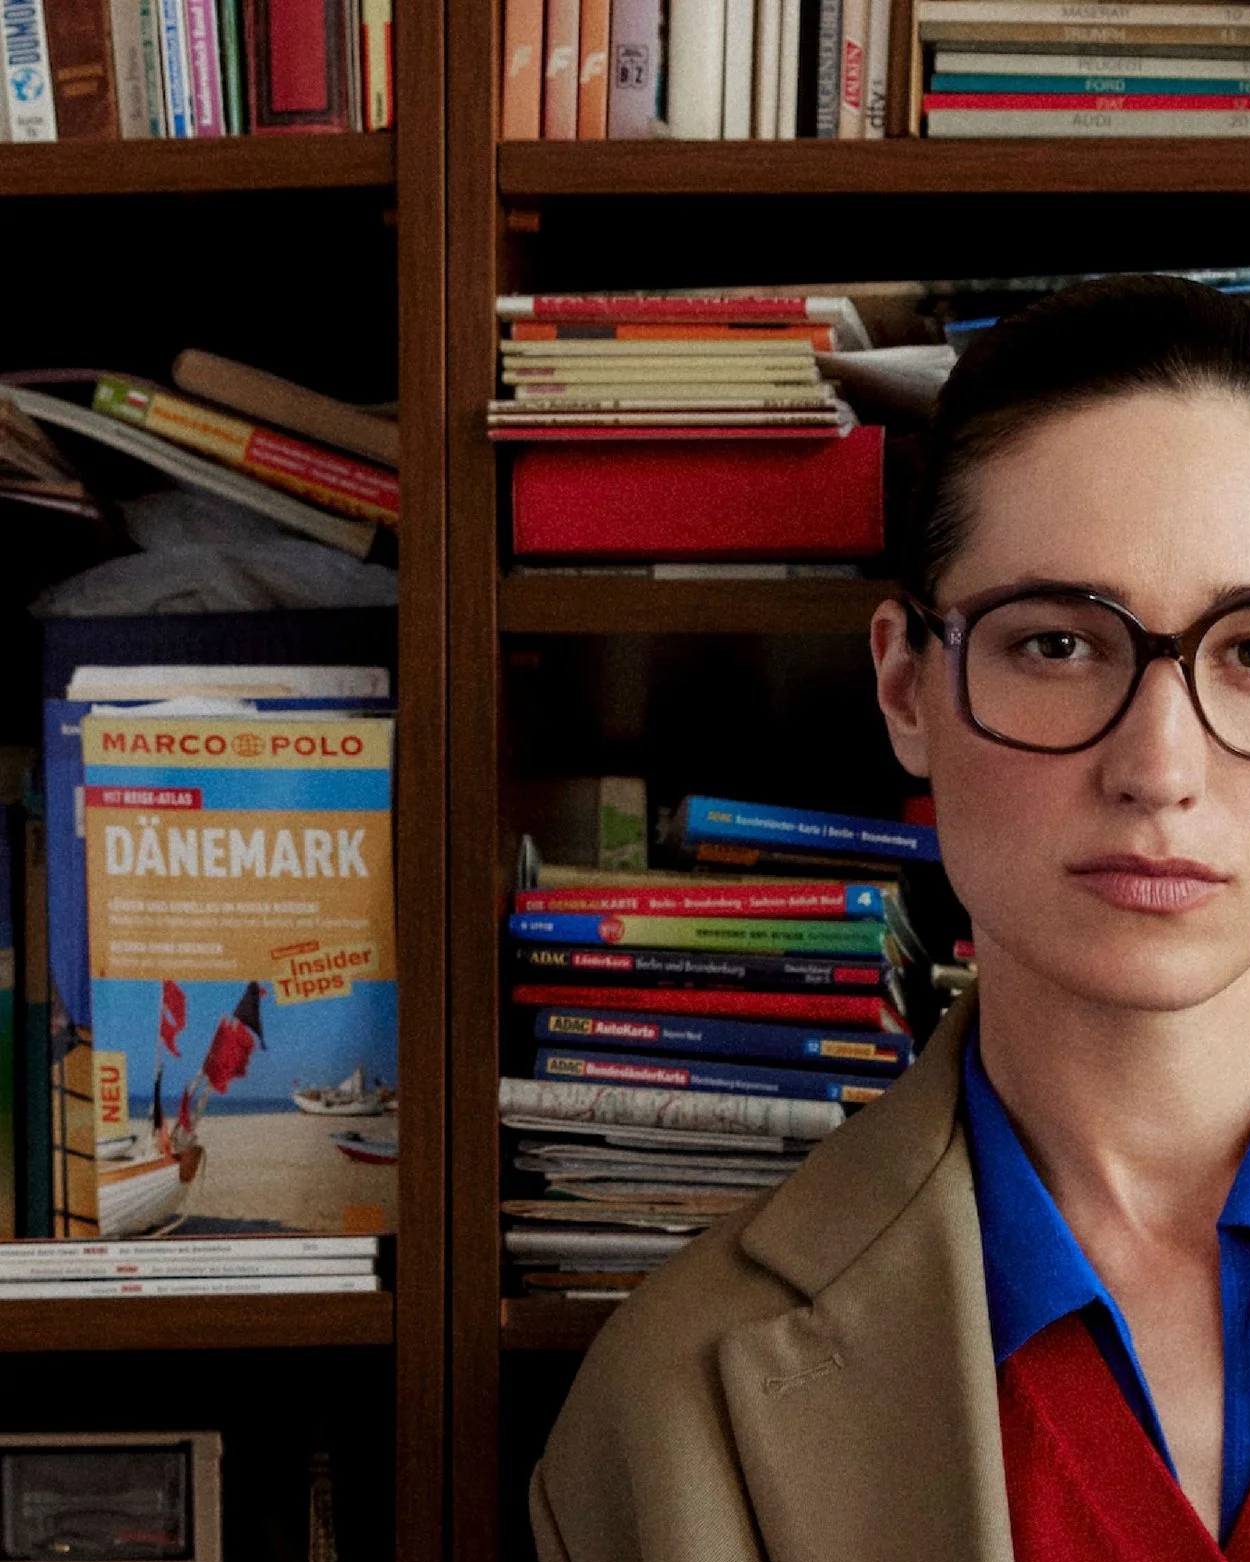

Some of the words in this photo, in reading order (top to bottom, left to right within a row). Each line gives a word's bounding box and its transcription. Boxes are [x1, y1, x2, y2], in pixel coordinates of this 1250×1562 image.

[4, 0, 41, 65] DUMO
[1083, 79, 1126, 92] FORD
[1072, 113, 1112, 127] AUDI
[101, 731, 228, 758] MARCO
[270, 734, 365, 758] POLO
[103, 815, 369, 879] DÄNEMARK
[857, 890, 873, 908] 4
[289, 947, 373, 977] Insider
[277, 972, 346, 1000] Tipps
[553, 1017, 592, 1033] ADAC
[595, 1020, 657, 1039] AutoKarte
[549, 1058, 584, 1074] ADAC
[101, 1064, 122, 1125] NEU
